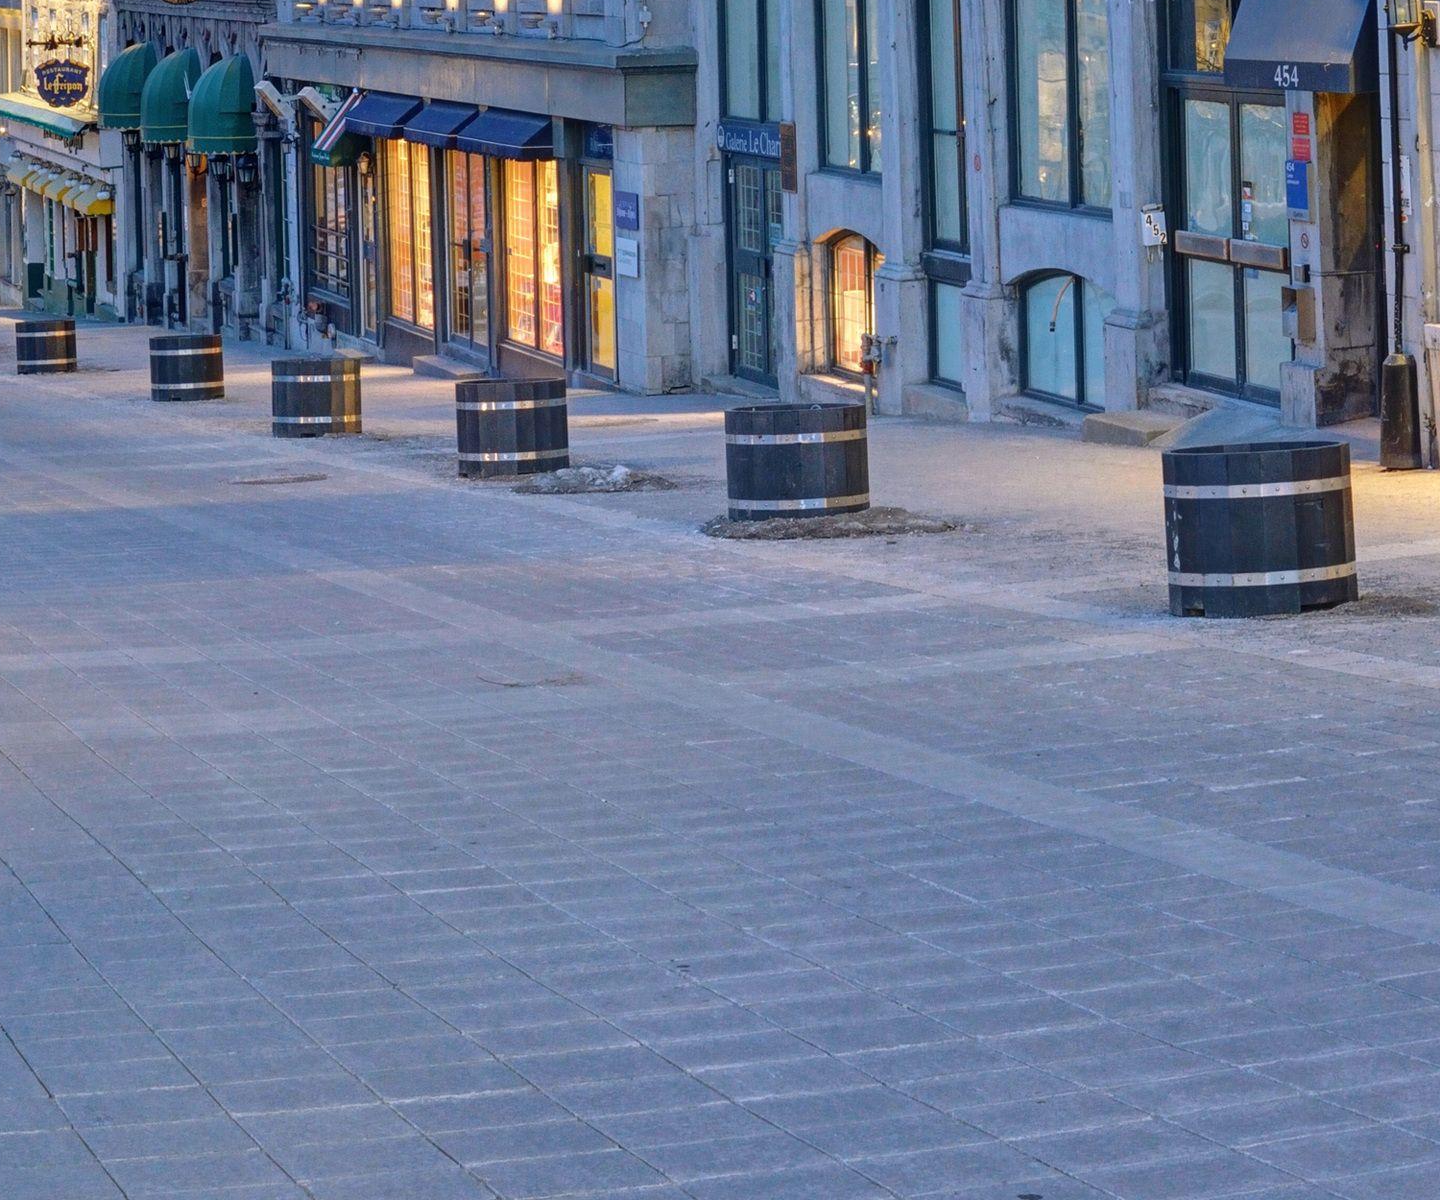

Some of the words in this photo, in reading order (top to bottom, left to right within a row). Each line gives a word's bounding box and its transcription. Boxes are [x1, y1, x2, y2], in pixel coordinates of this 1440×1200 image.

[1274, 65, 1300, 87] 454
[725, 132, 748, 152] Galerie
[749, 130, 760, 154] Le
[760, 131, 782, 158] Chari
[1145, 214, 1167, 244] 452
